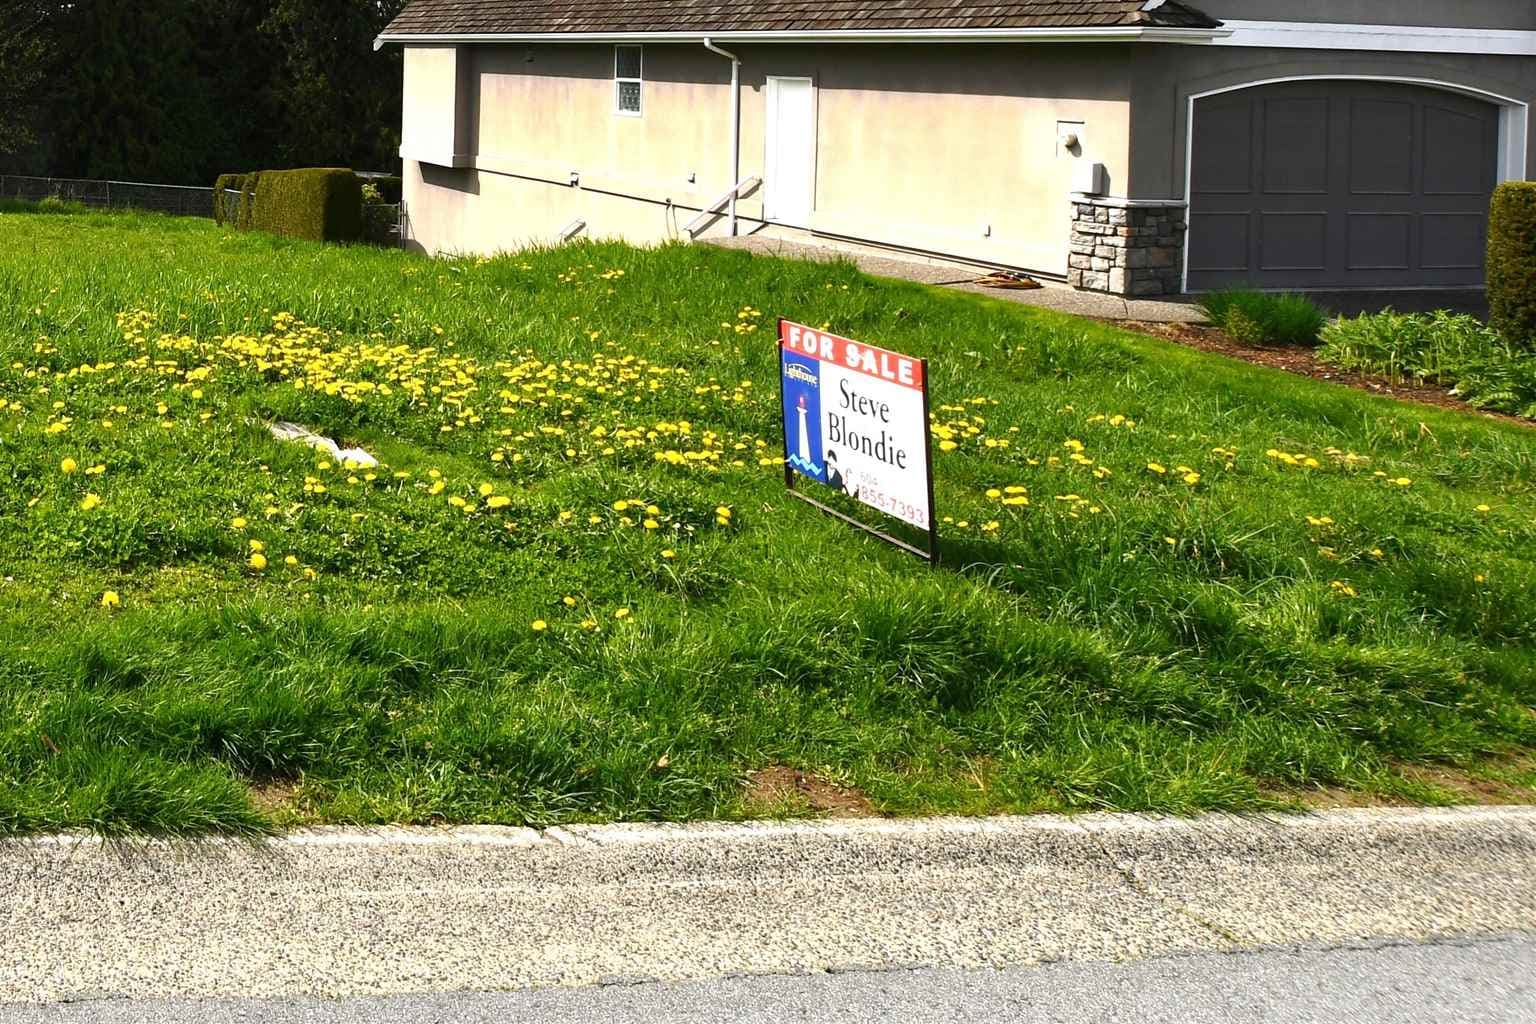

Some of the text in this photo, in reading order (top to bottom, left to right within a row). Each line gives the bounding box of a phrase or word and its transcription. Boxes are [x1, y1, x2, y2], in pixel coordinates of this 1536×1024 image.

[789, 327, 834, 361] FOR
[845, 343, 913, 385] SALE
[839, 378, 889, 423] Steve
[829, 412, 906, 469] Blondie
